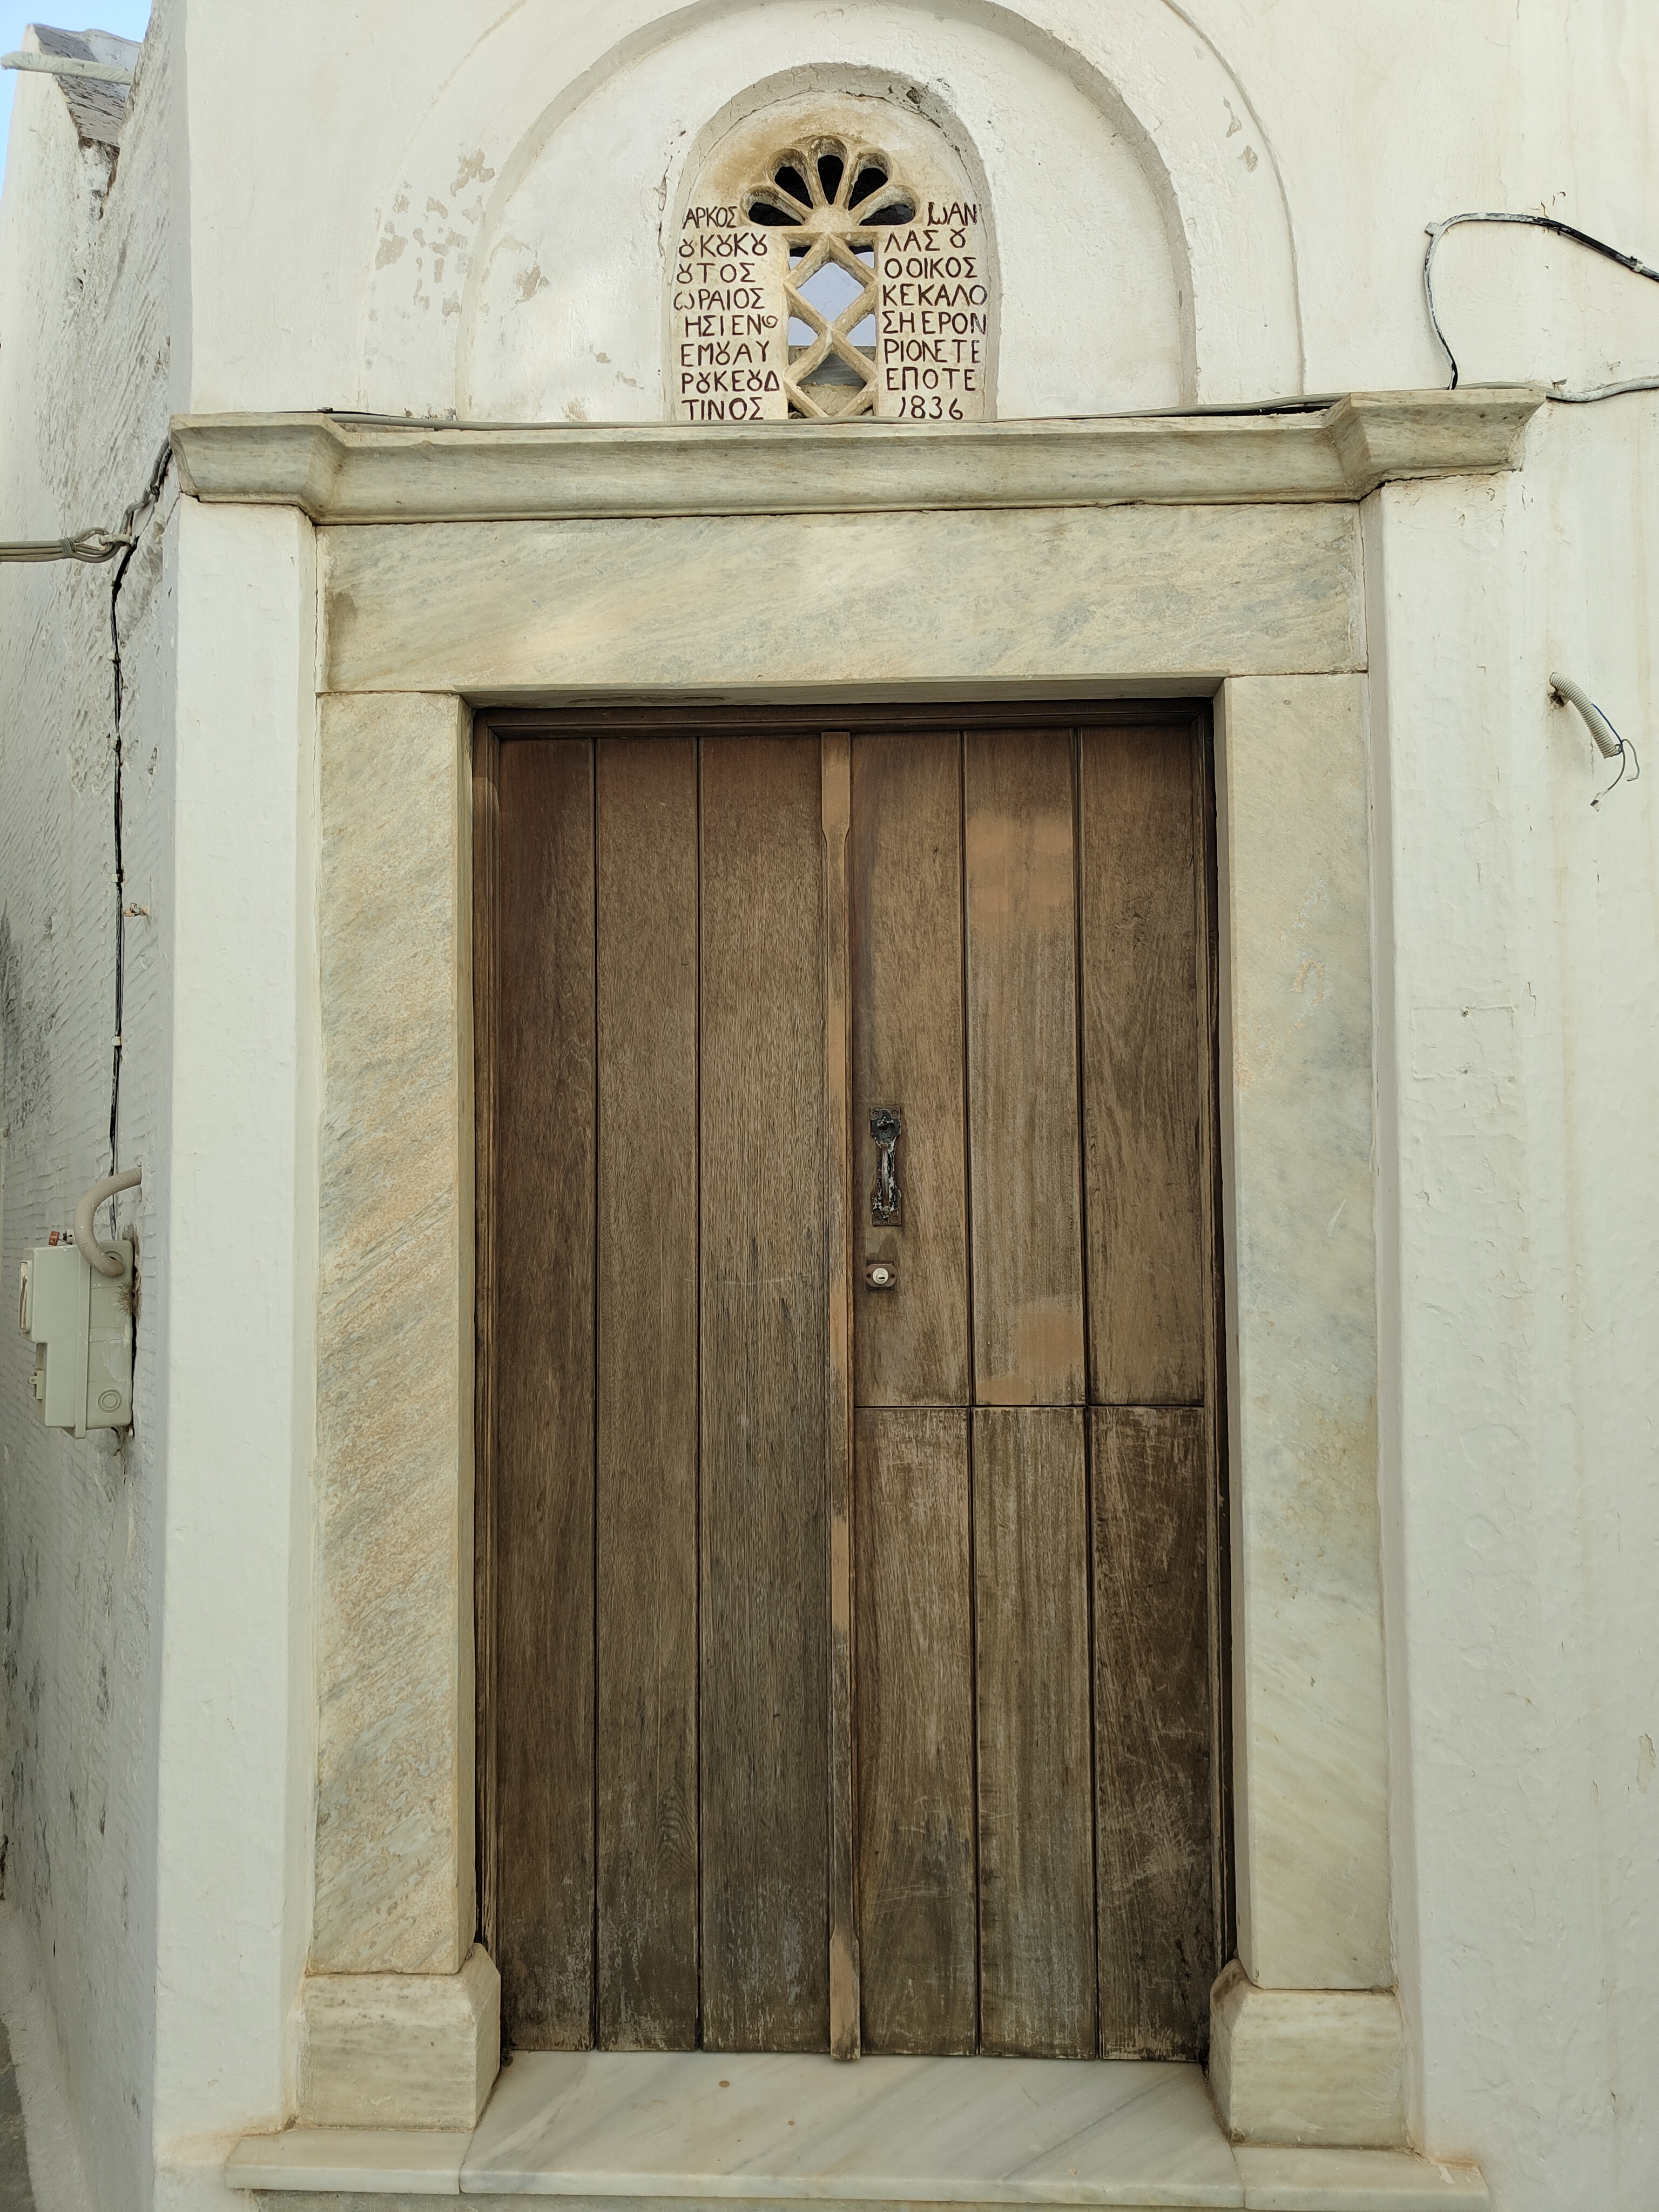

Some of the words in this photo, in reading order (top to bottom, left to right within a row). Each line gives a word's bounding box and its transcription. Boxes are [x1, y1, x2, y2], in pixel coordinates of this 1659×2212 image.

[682, 206, 738, 230] ΑΡΚΟΣ
[886, 366, 976, 392] ΕΠΟΤΕ
[681, 396, 764, 421] ΤΙΝΟΣ
[898, 395, 963, 420] 1836
